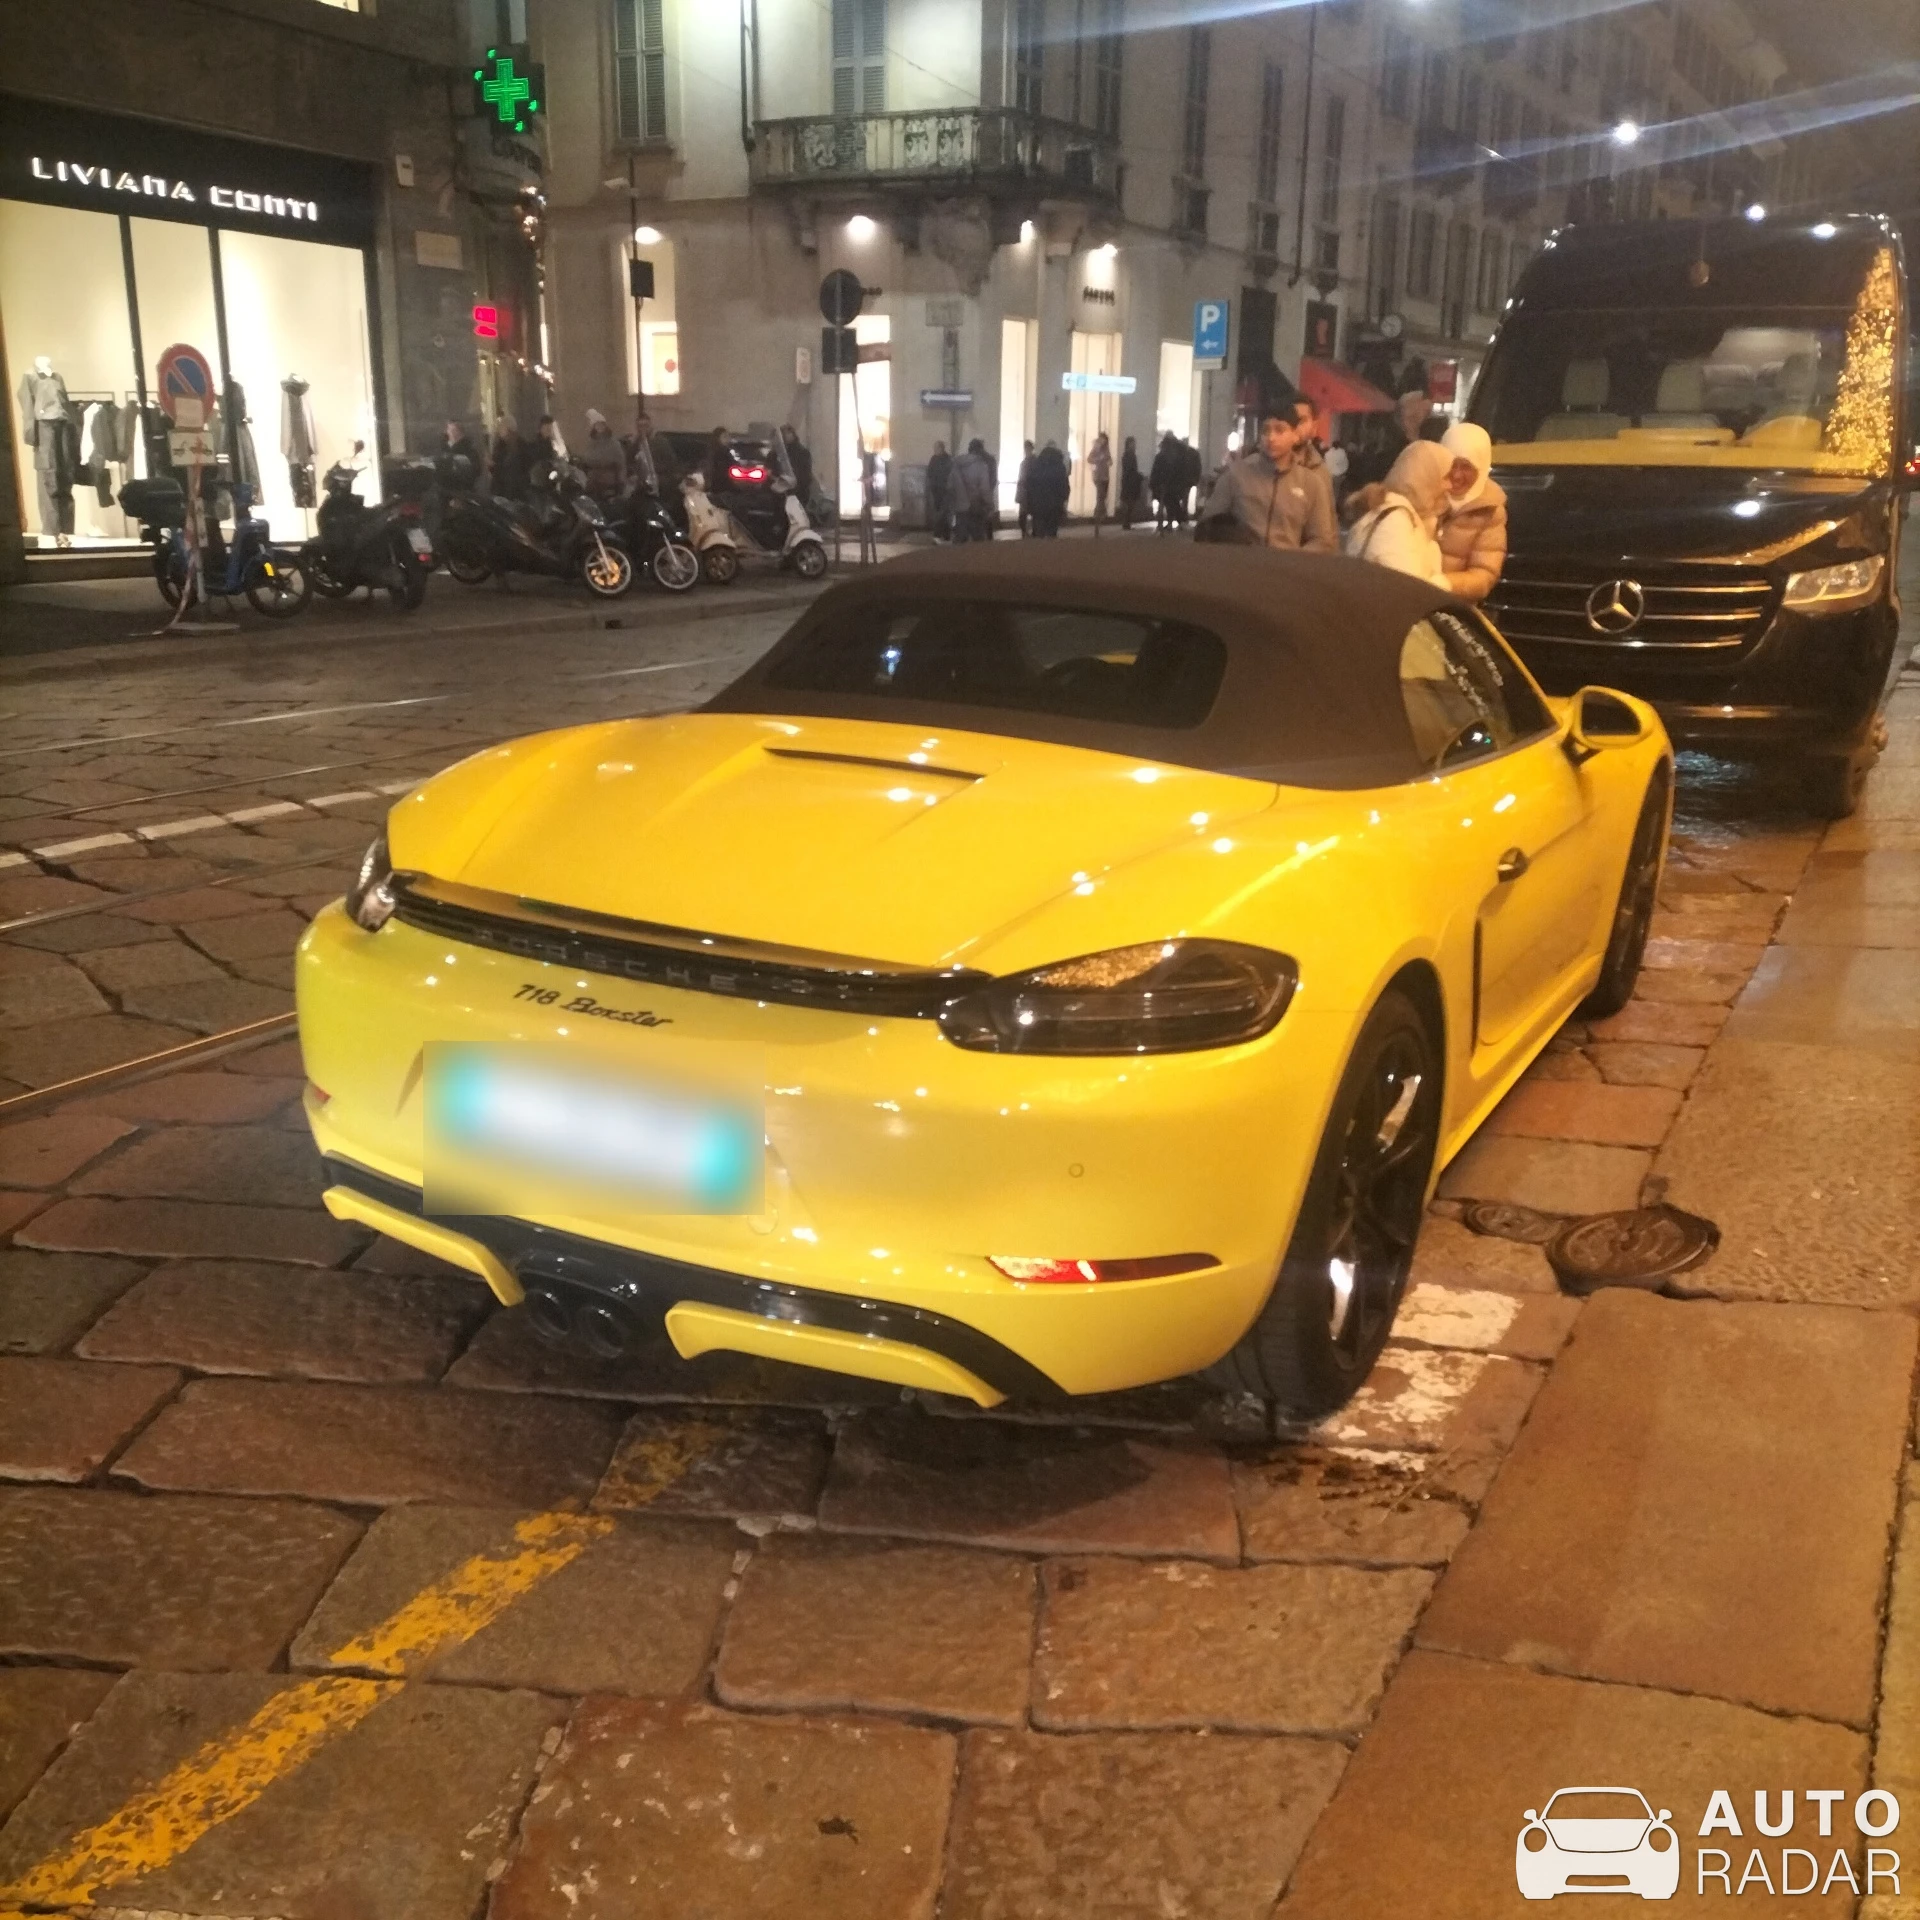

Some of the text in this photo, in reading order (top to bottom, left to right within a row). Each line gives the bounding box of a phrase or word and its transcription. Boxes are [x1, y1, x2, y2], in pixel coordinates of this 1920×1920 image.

[31, 156, 318, 222] LIVIANA CONTI
[1201, 304, 1221, 333] P
[513, 984, 674, 1027] 718 Boxster
